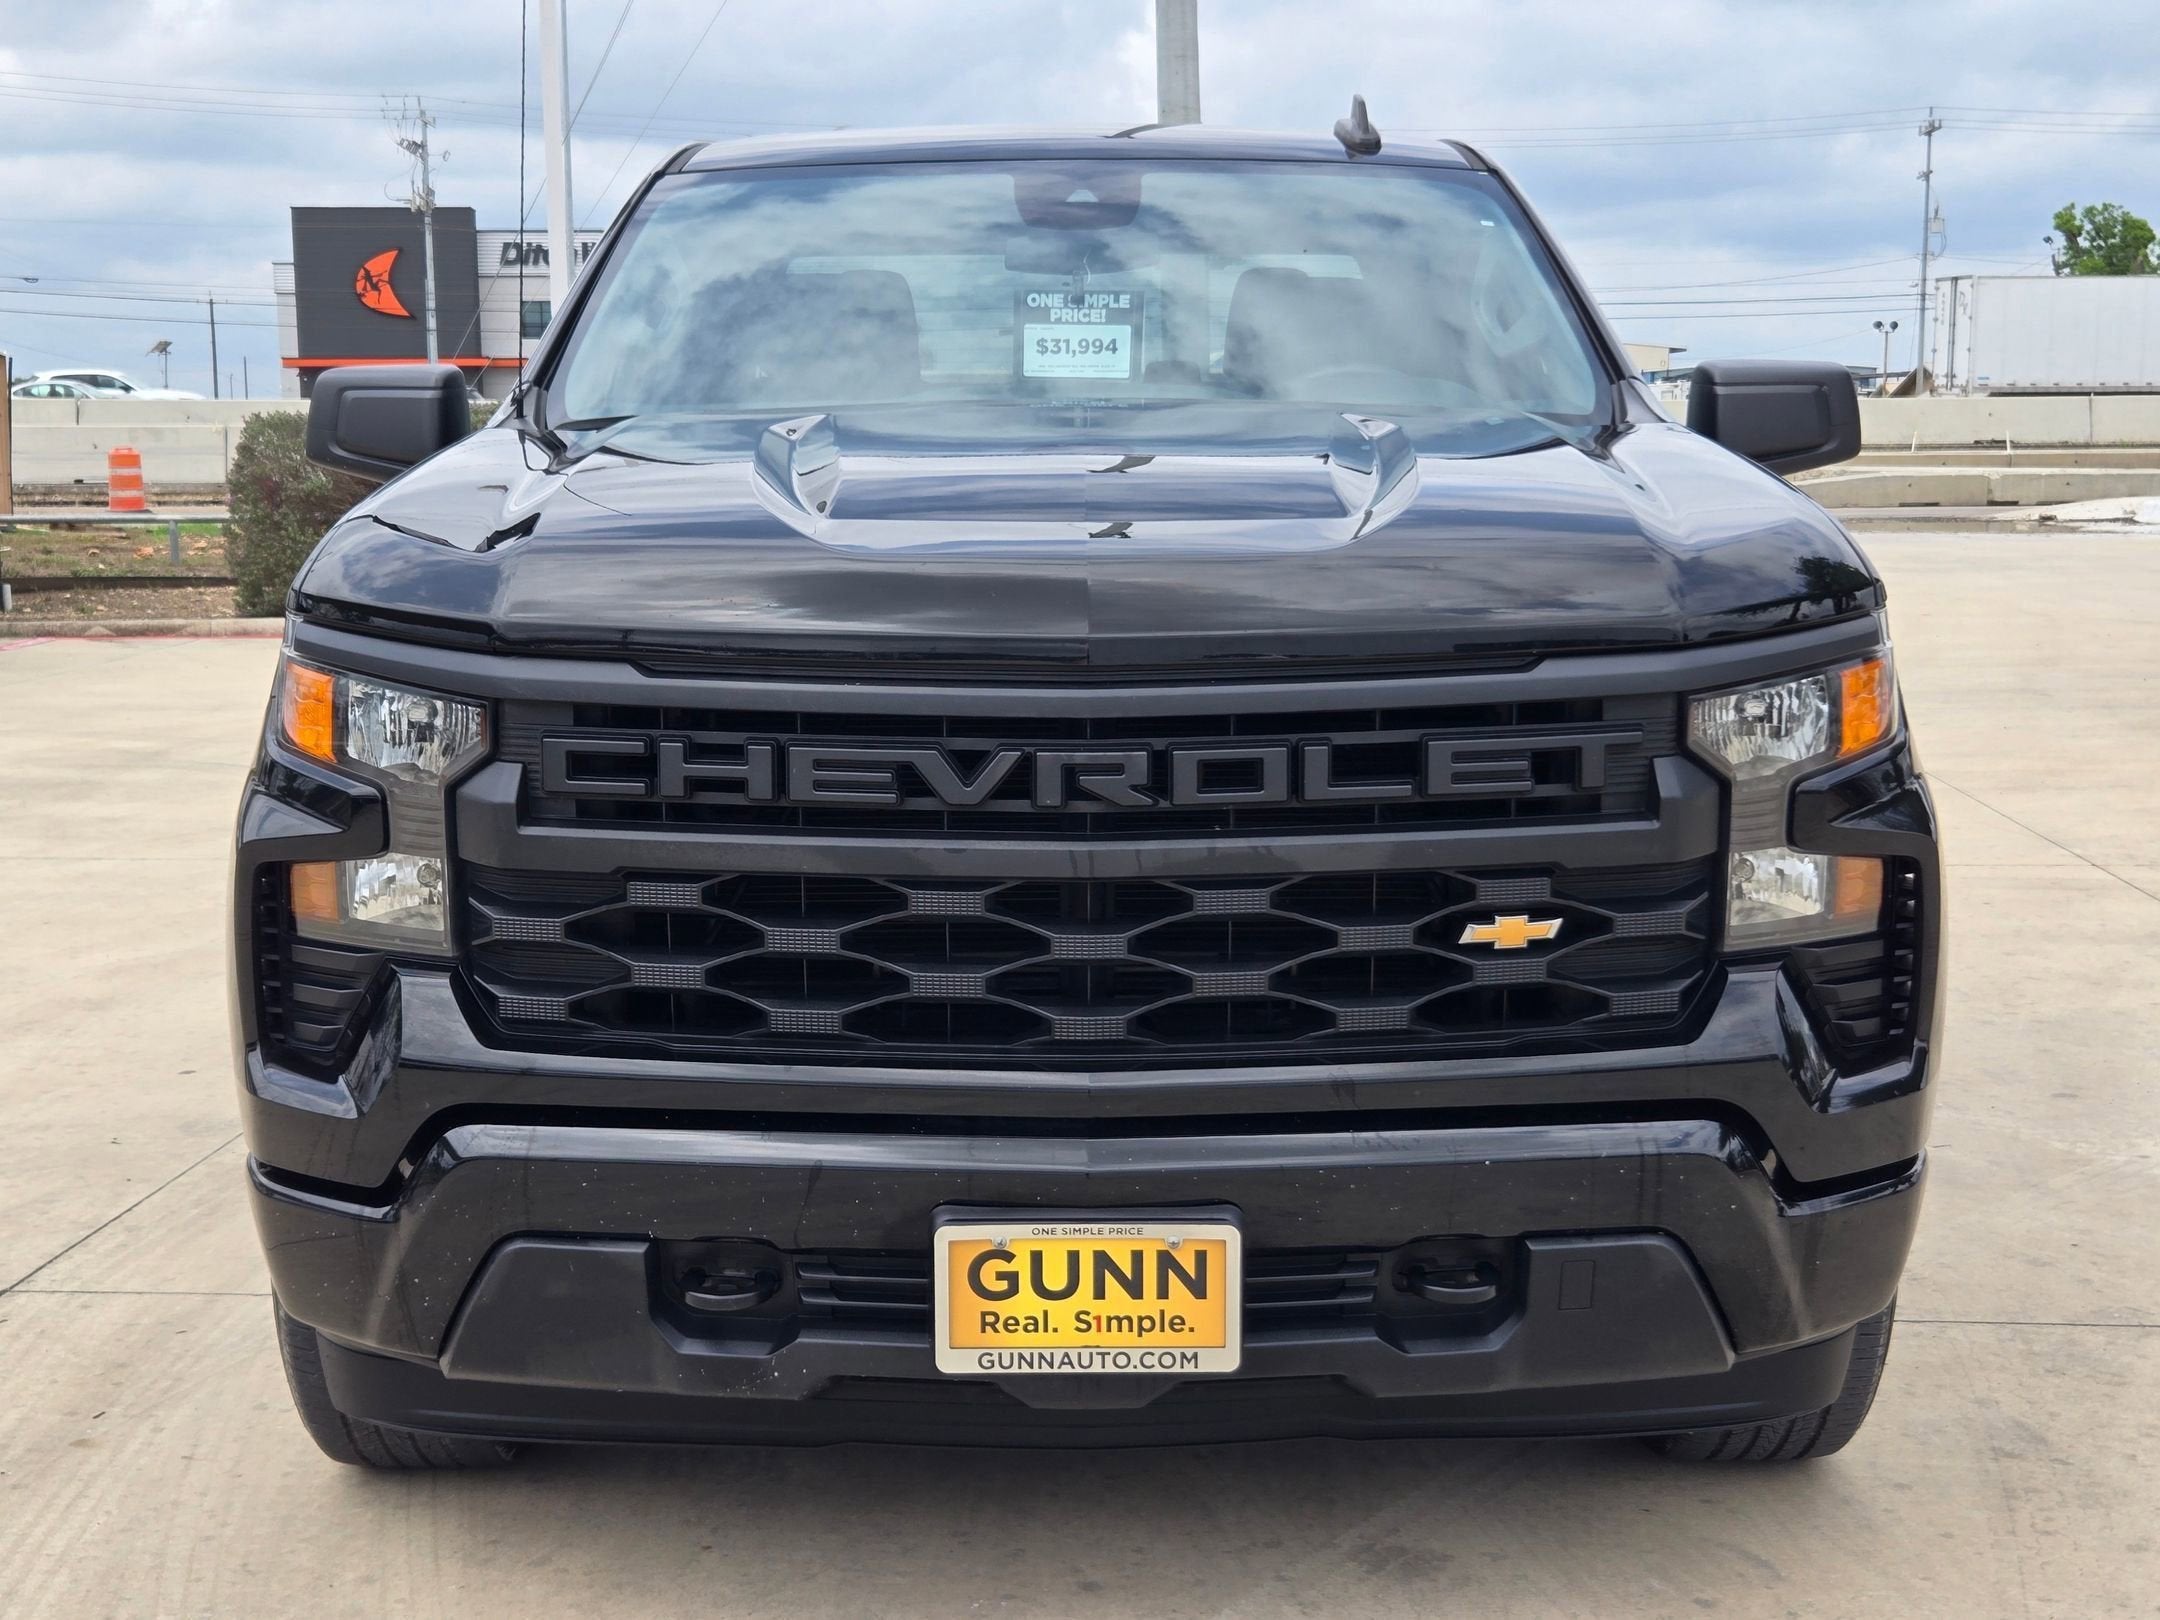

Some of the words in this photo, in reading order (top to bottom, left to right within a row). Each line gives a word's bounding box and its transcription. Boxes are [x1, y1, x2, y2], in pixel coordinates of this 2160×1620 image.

[500, 242, 577, 265] Dit
[1026, 293, 1064, 307] ONE
[1067, 294, 1130, 308] MPLE
[1050, 308, 1106, 322] PRICE!
[1036, 337, 1118, 357] $31,994
[541, 730, 1644, 806] CHEVROLET
[1031, 1227, 1057, 1236] ONE
[1061, 1227, 1105, 1236] SIMPLE
[1108, 1227, 1144, 1236] PRICE
[967, 1248, 1208, 1301] GUNN
[980, 1310, 1058, 1334] Real.
[977, 1351, 1199, 1370] GUNNAUTO.COM
